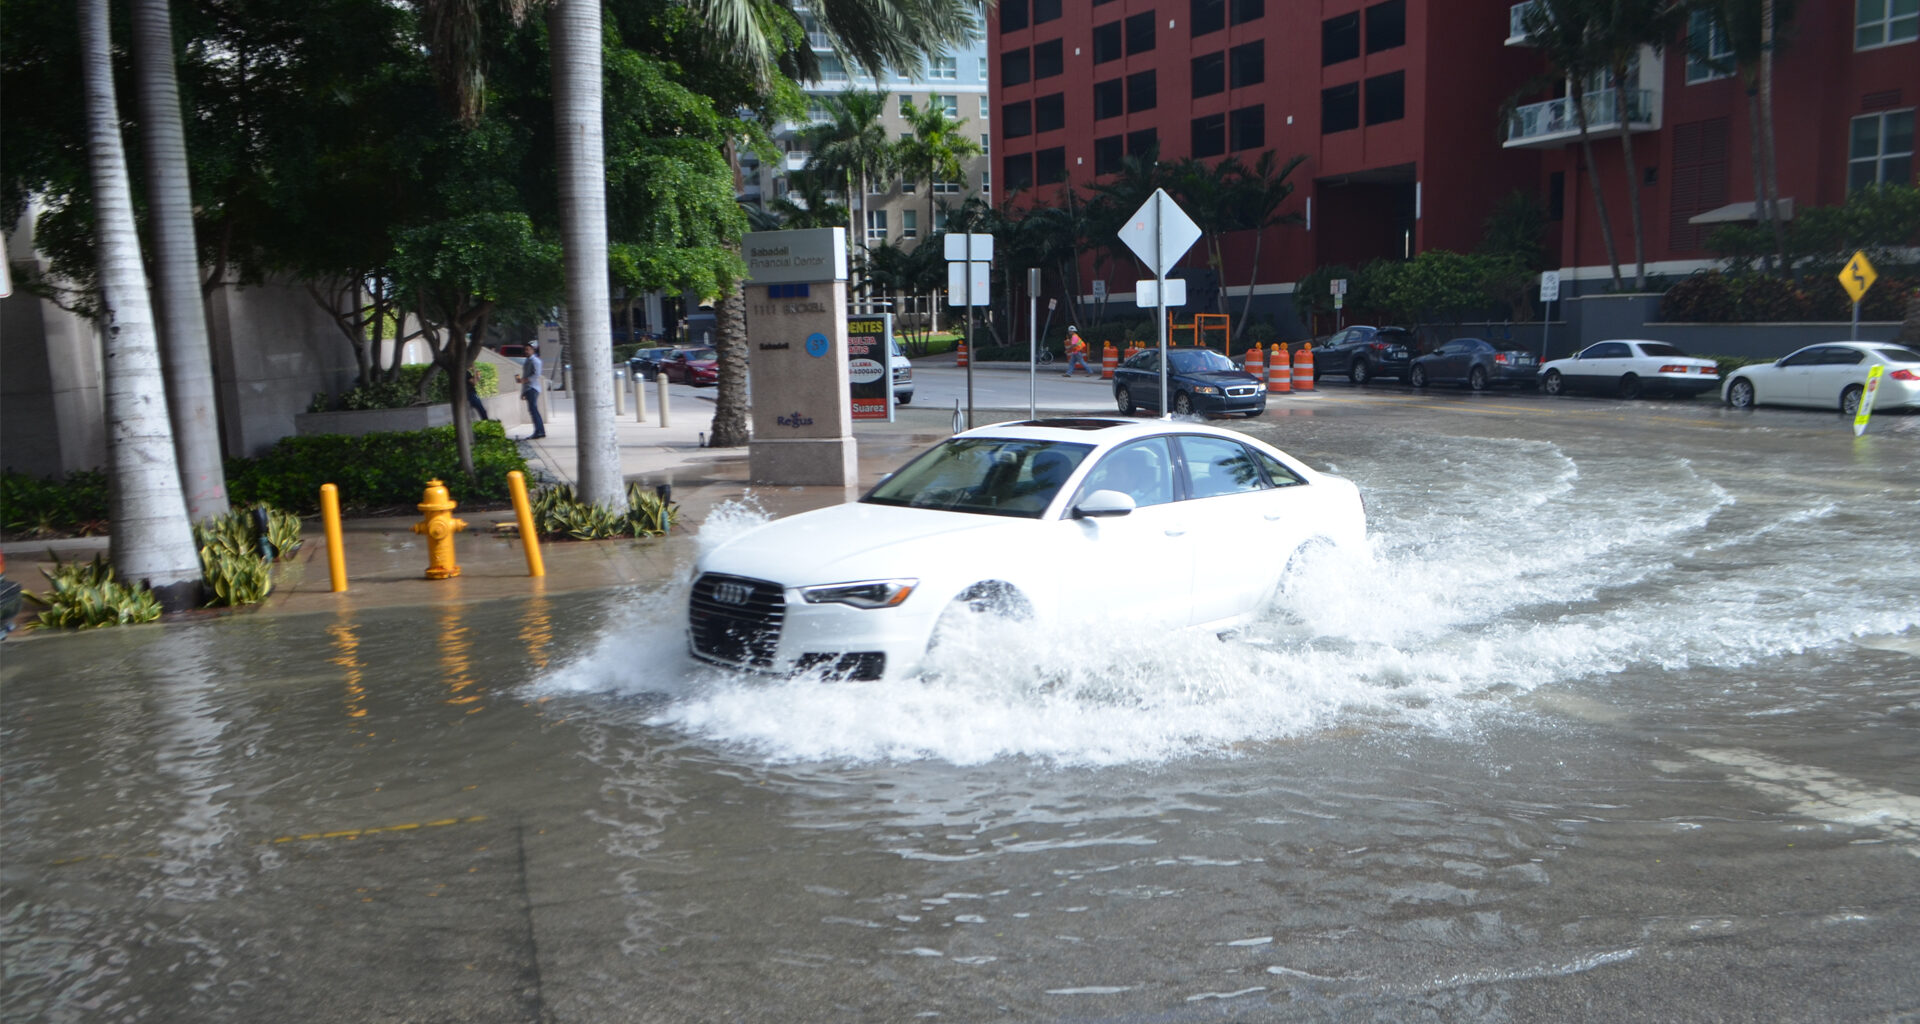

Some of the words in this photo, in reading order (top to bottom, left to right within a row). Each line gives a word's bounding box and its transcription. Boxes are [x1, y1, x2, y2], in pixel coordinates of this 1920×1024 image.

[751, 246, 789, 257] Sabadell
[751, 257, 791, 268] Financial
[794, 255, 825, 266] Center
[852, 403, 885, 413] Suarez
[777, 415, 814, 428] Regus
